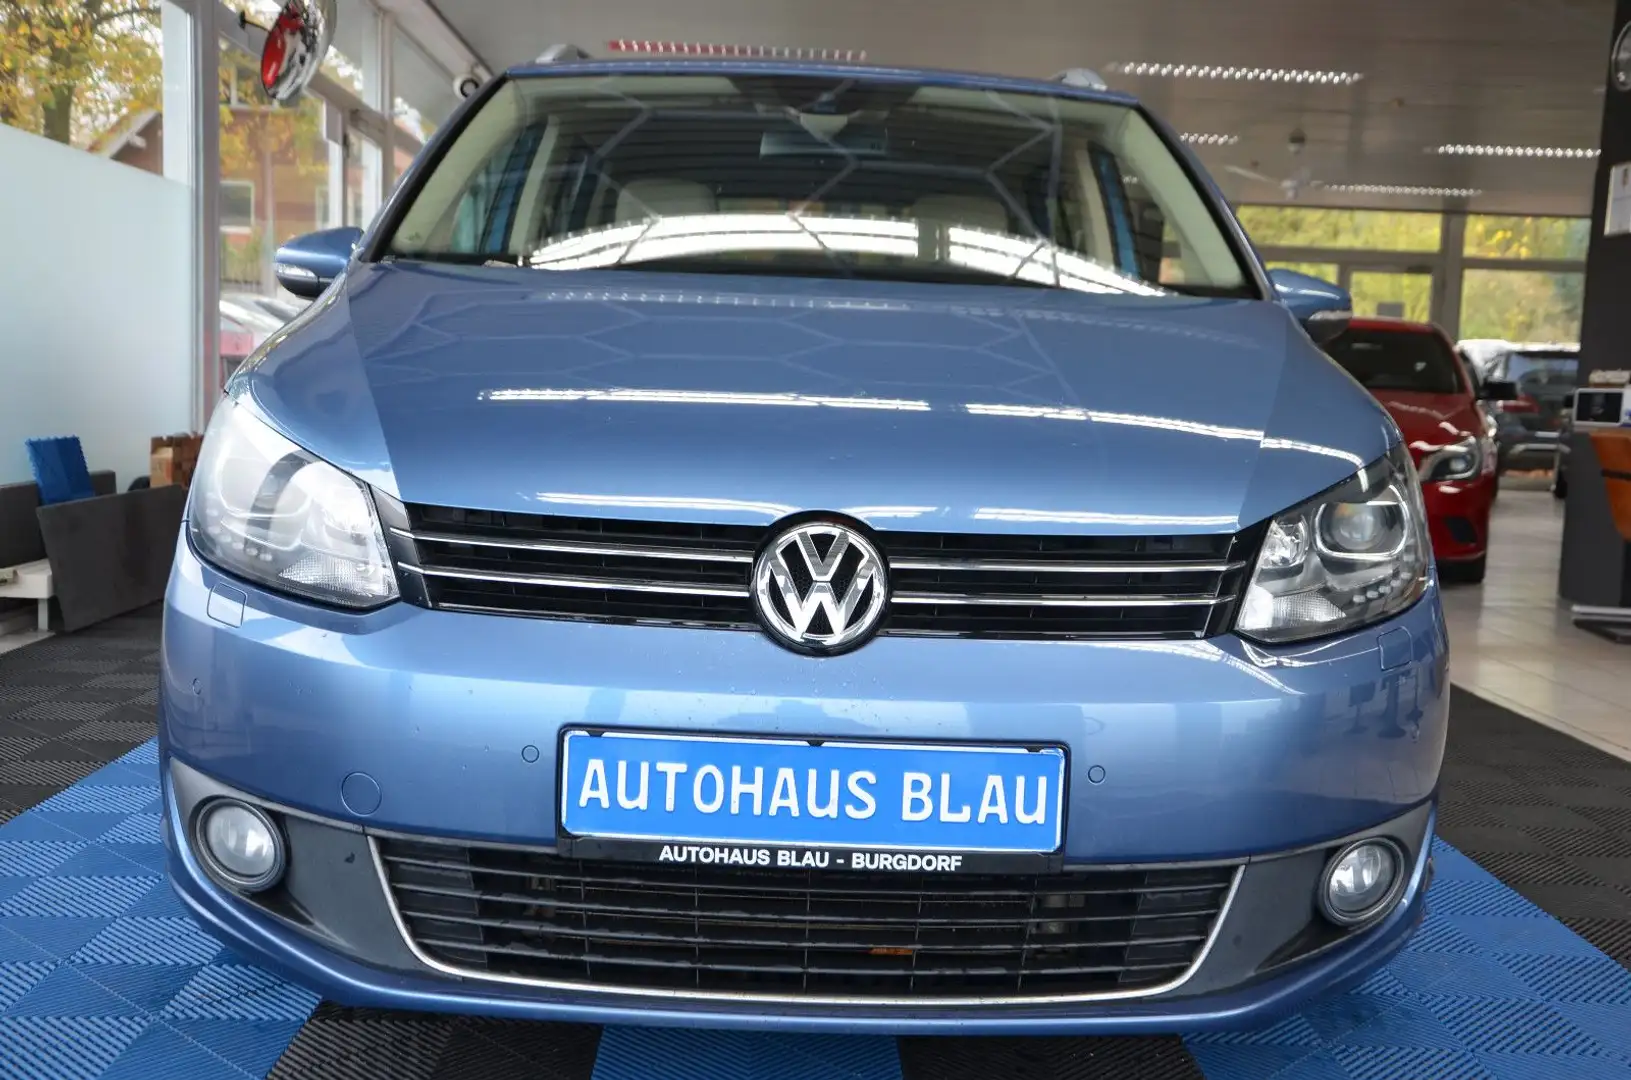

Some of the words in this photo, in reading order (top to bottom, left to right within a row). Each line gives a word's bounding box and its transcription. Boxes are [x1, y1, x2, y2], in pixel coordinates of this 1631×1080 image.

[763, 527, 881, 645] VW
[578, 758, 877, 820] AUTOHAUS
[901, 771, 1048, 825] BLAU
[658, 845, 771, 866] AUTOHAUS
[777, 850, 830, 868] BLAU
[851, 852, 963, 872] BURGDORF
